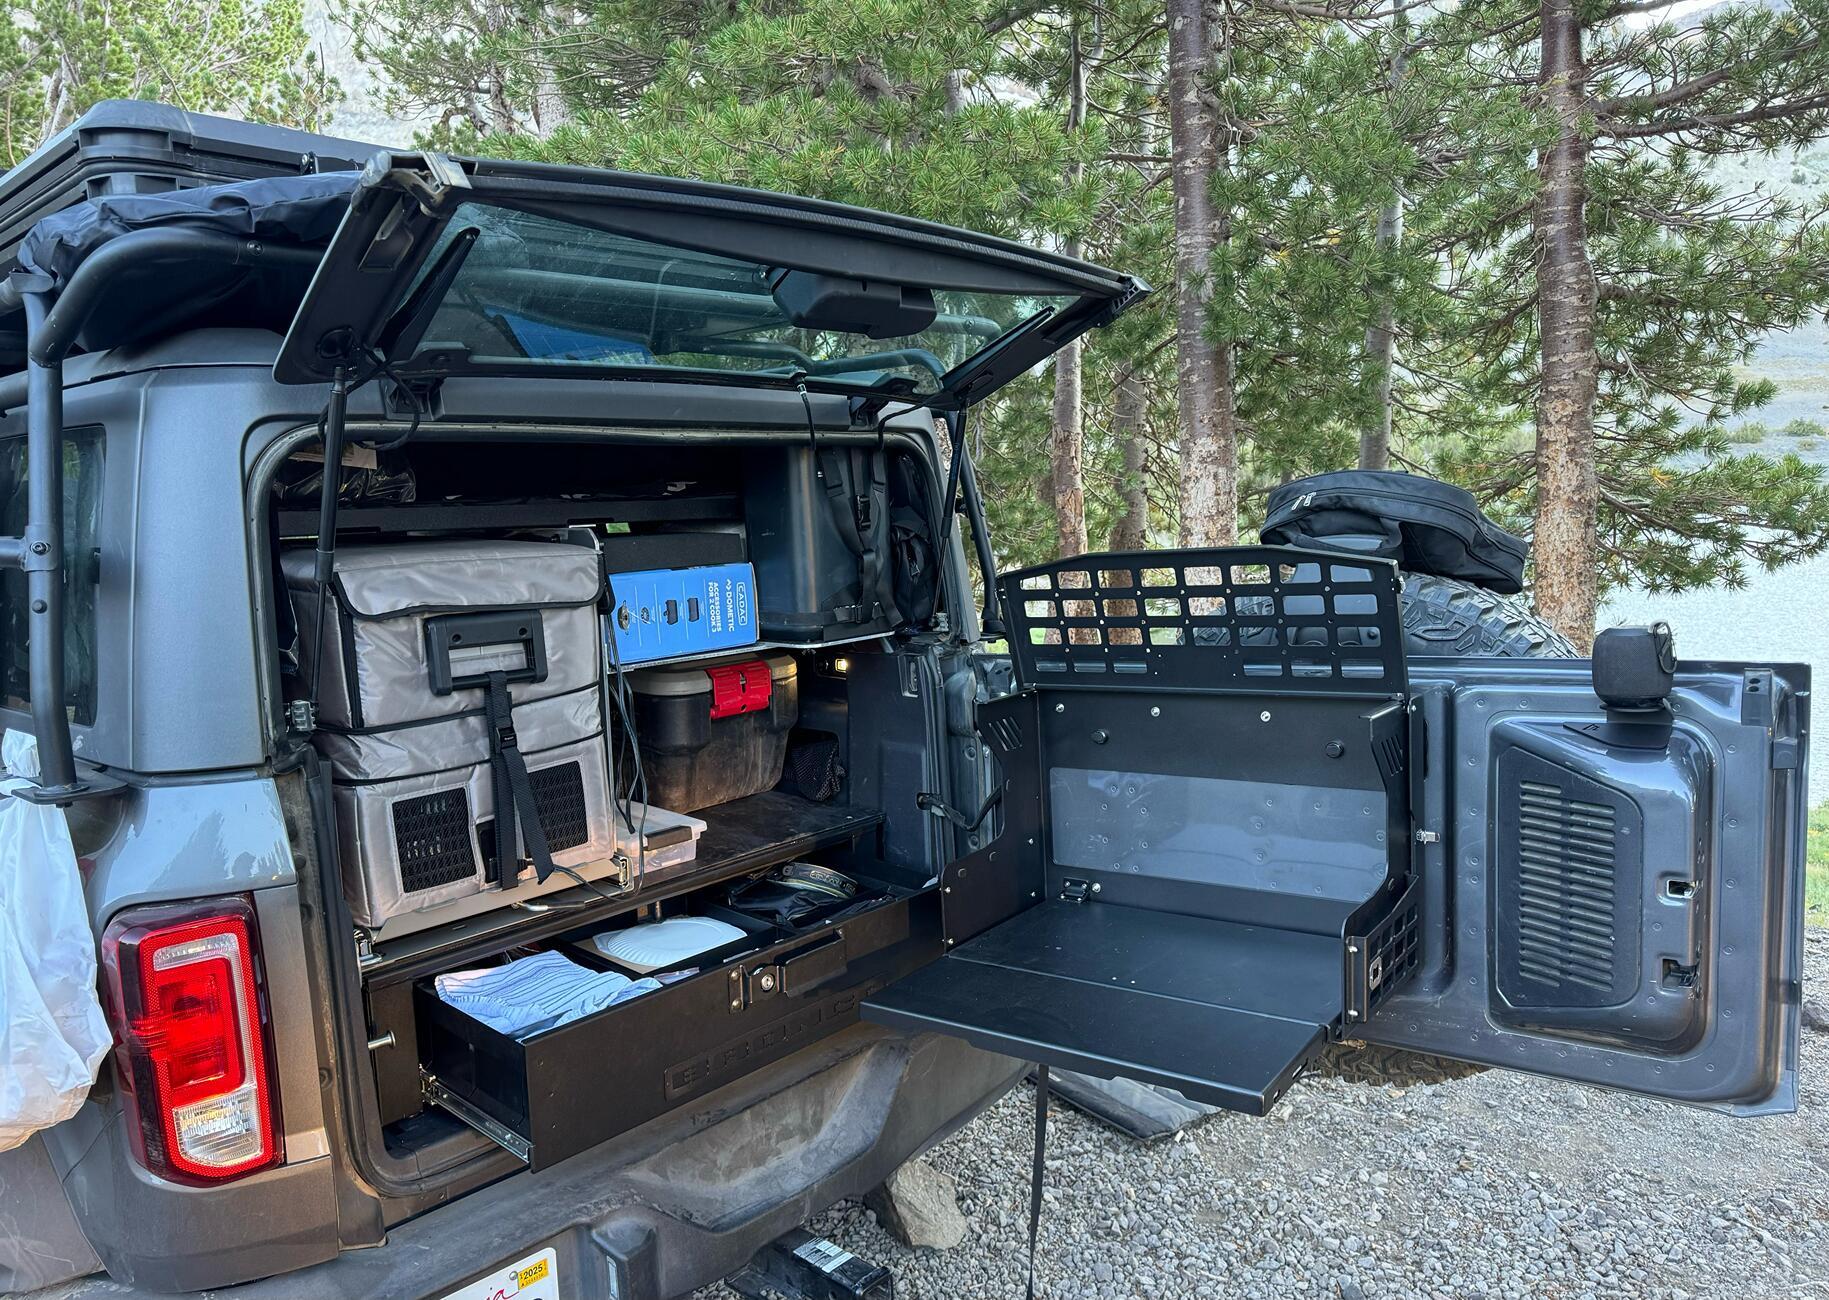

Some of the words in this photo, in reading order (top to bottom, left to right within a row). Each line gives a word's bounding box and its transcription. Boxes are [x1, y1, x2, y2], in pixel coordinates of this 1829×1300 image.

[713, 582, 722, 632] ACCESSORIES
[726, 591, 735, 632] DOMETIC
[738, 584, 746, 623] CADAC
[524, 1263, 543, 1280] 2025
